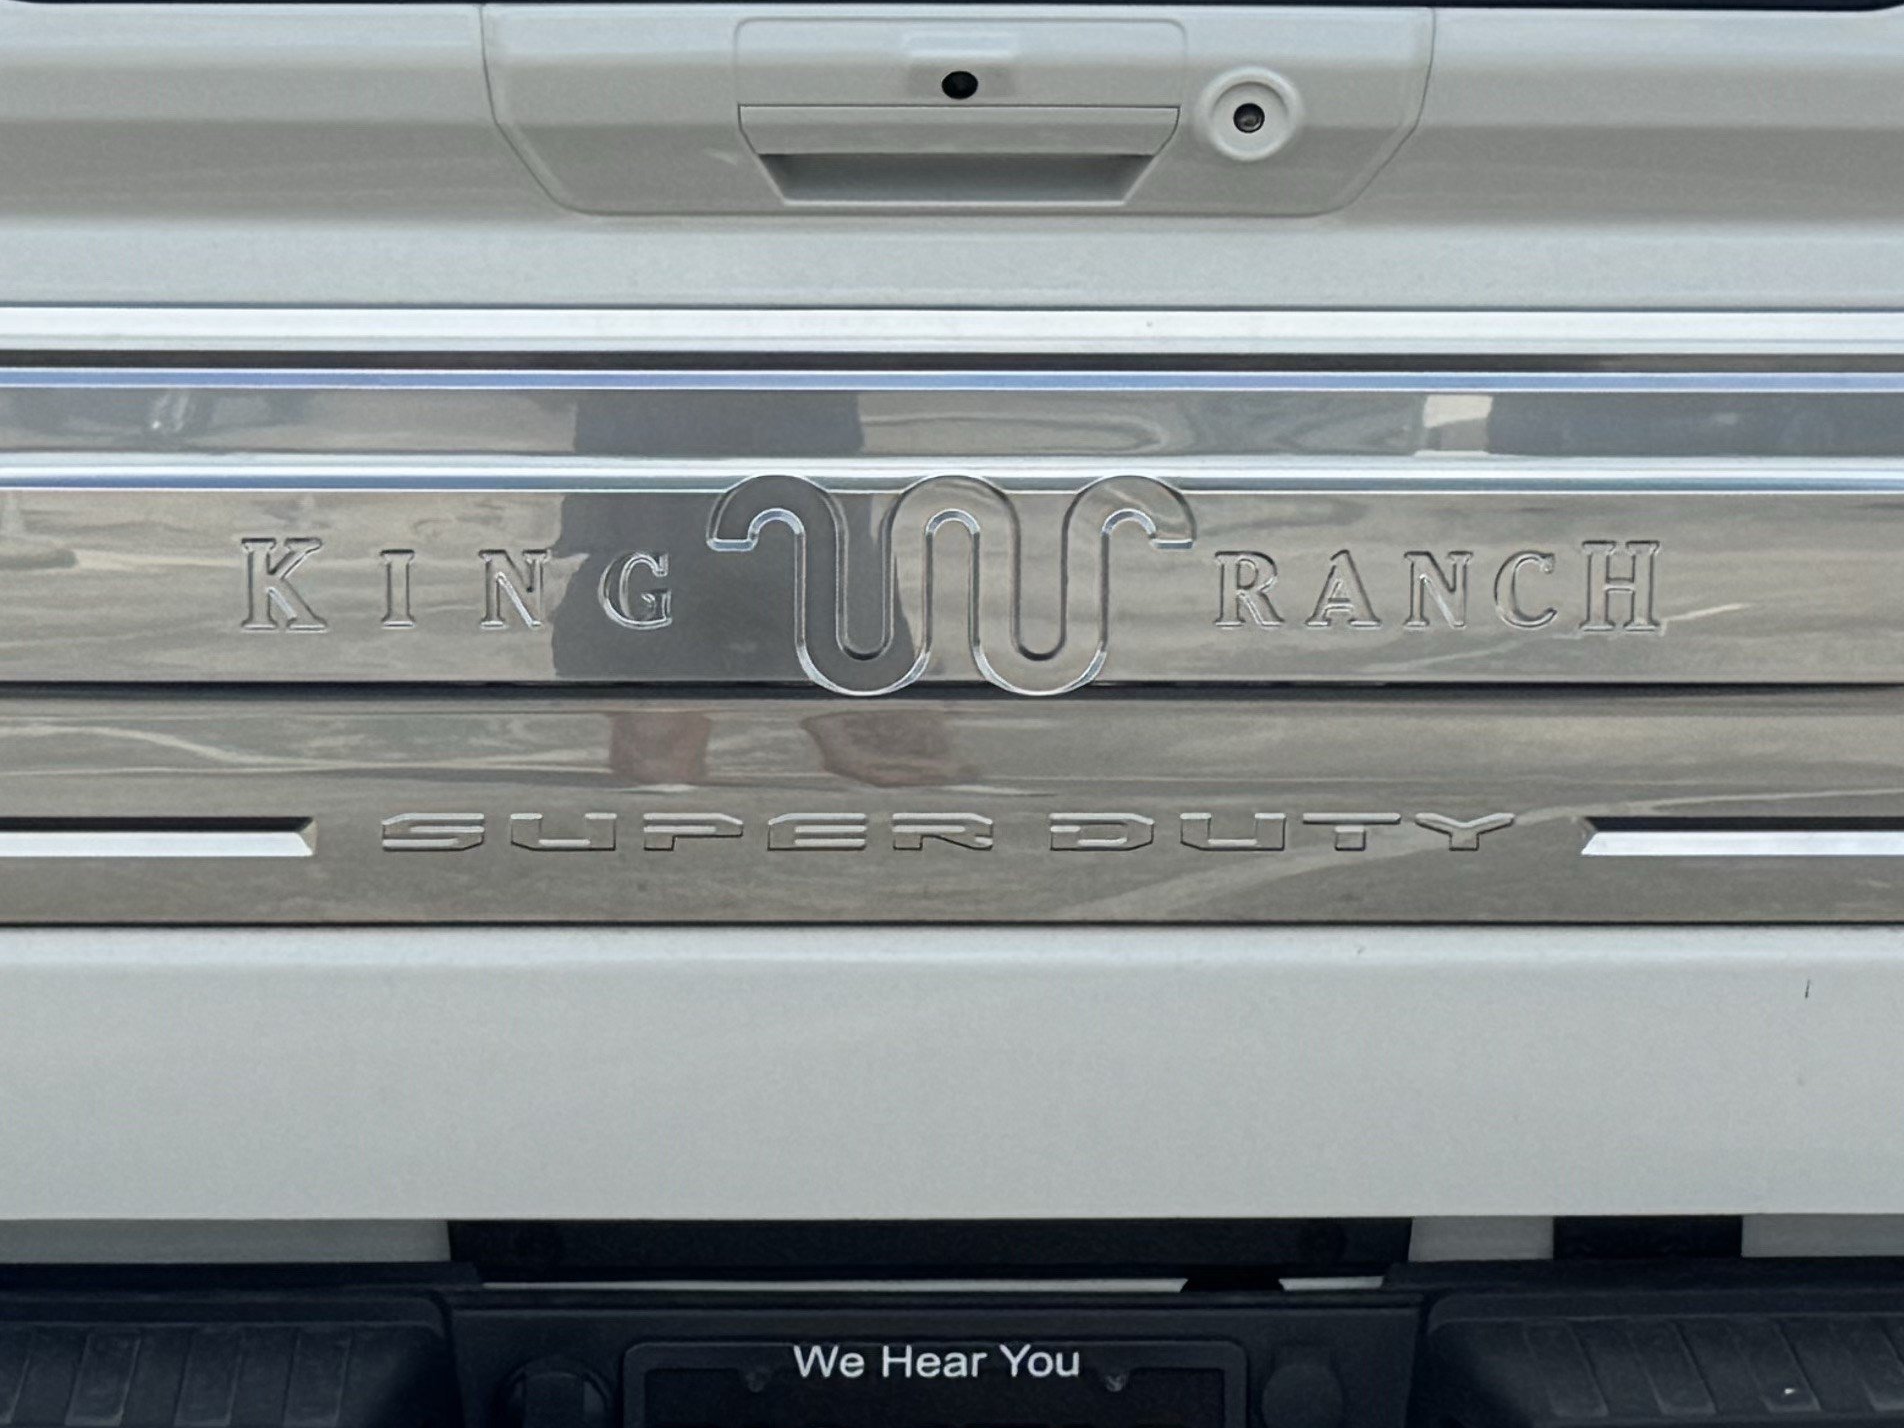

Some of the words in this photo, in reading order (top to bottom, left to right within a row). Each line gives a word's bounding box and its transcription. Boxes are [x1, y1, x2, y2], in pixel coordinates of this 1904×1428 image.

[240, 536, 673, 633] KING
[1213, 539, 1664, 633] RANCH
[381, 812, 995, 851] SUPER
[1049, 812, 1515, 851] DUTY
[794, 1345, 864, 1377] We
[882, 1345, 987, 1377] Hear
[999, 1344, 1079, 1377] You
